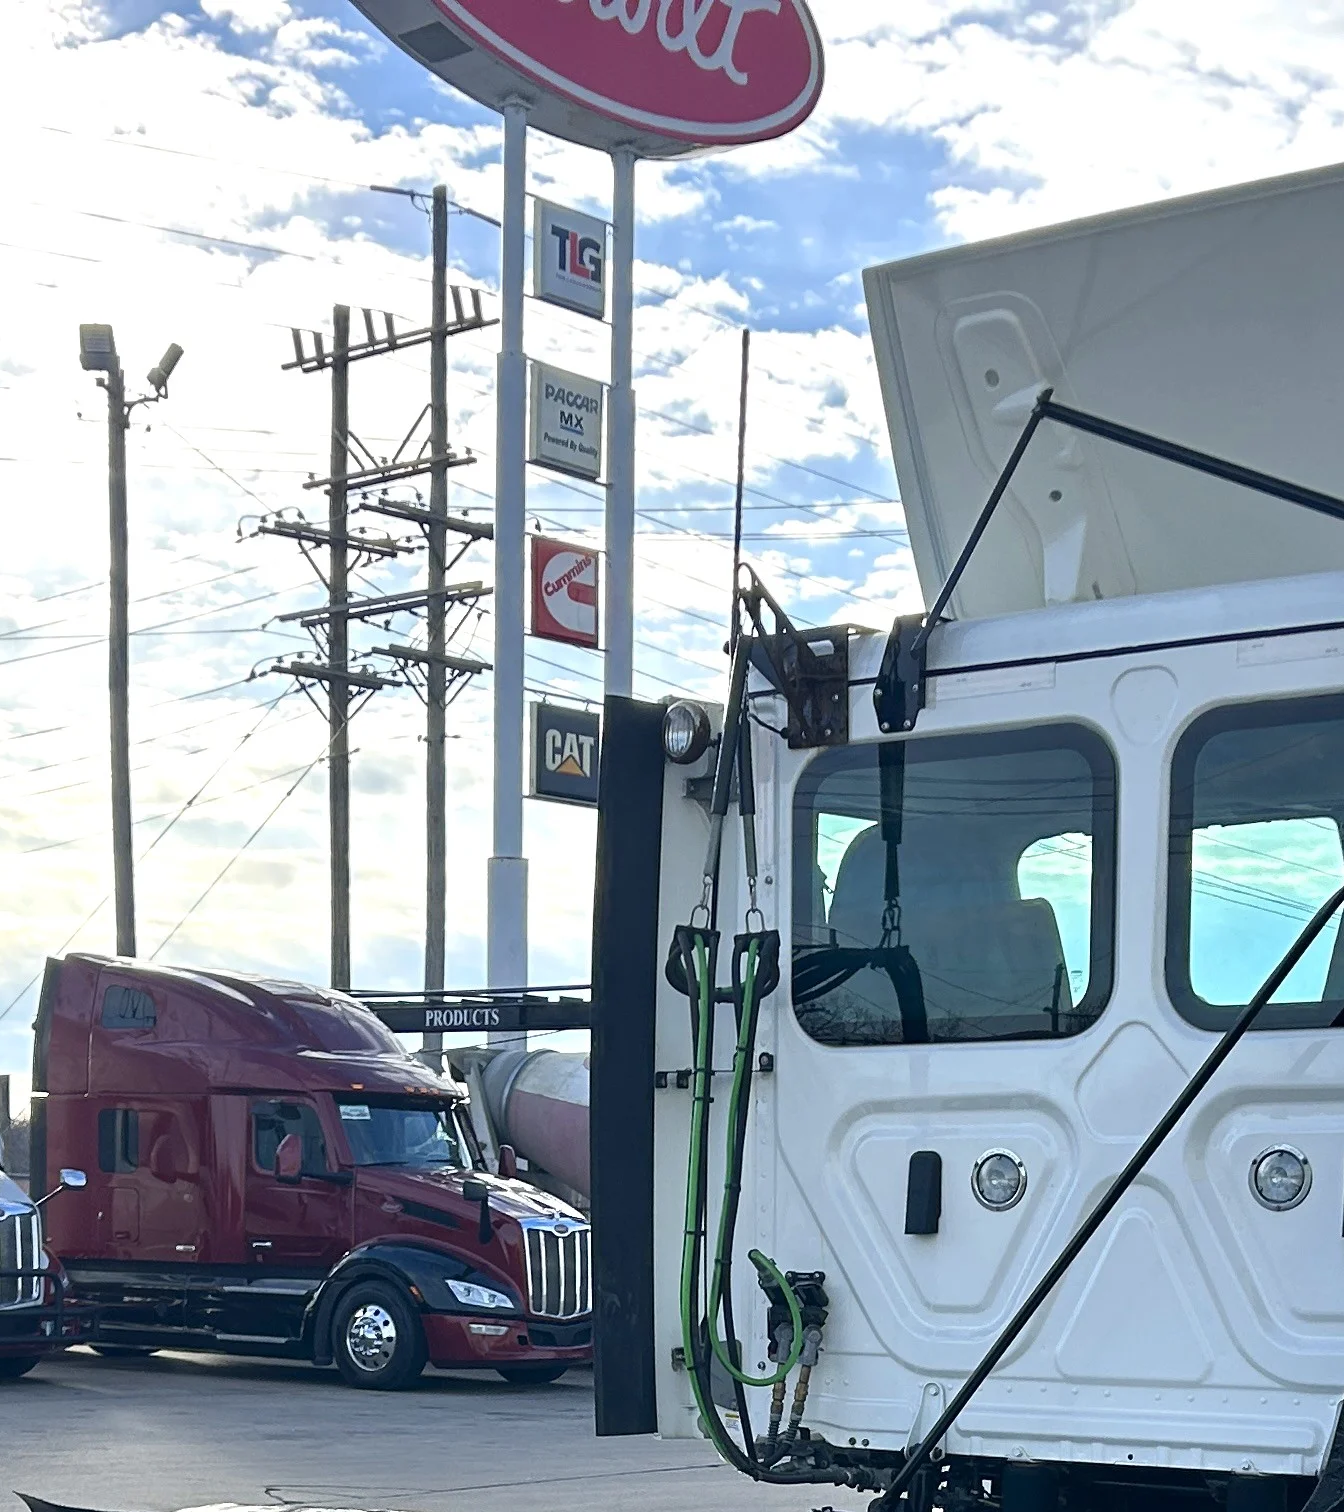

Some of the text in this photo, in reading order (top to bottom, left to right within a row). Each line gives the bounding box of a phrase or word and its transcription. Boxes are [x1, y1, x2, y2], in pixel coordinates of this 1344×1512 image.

[551, 223, 602, 284] TLG
[545, 383, 599, 415] PACCAR
[560, 410, 584, 431] MX
[544, 432, 598, 459] Powered By Quality
[544, 552, 592, 596] Cummins
[545, 728, 594, 778] CAT
[425, 1008, 500, 1027] PRODUCTS
